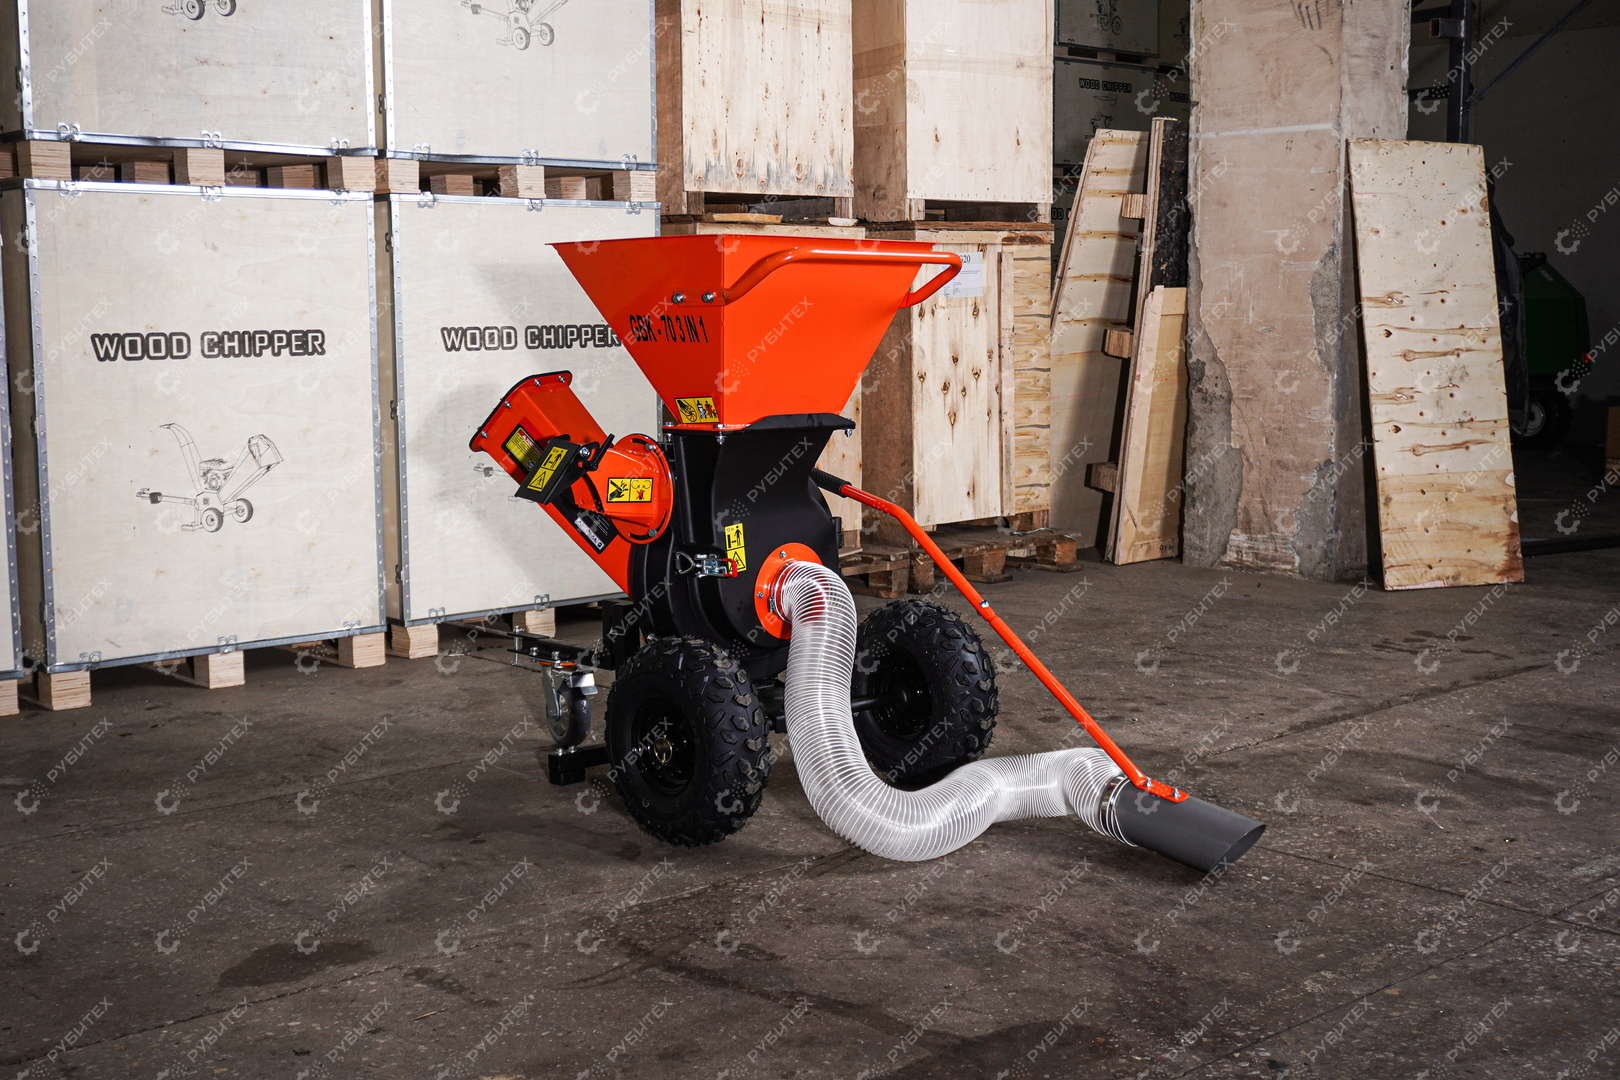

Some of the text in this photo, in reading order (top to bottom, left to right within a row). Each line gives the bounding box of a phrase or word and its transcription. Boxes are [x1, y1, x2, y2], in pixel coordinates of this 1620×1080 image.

[1079, 78, 1133, 93] WOOD CHIPPER
[440, 324, 622, 352] WOOD CHIPPER
[629, 315, 657, 342] GBK
[660, 315, 677, 342] 70
[675, 315, 686, 343] 3
[683, 315, 700, 343] IN
[699, 315, 709, 343] 1
[91, 330, 326, 361] WOOD CHIPPER
